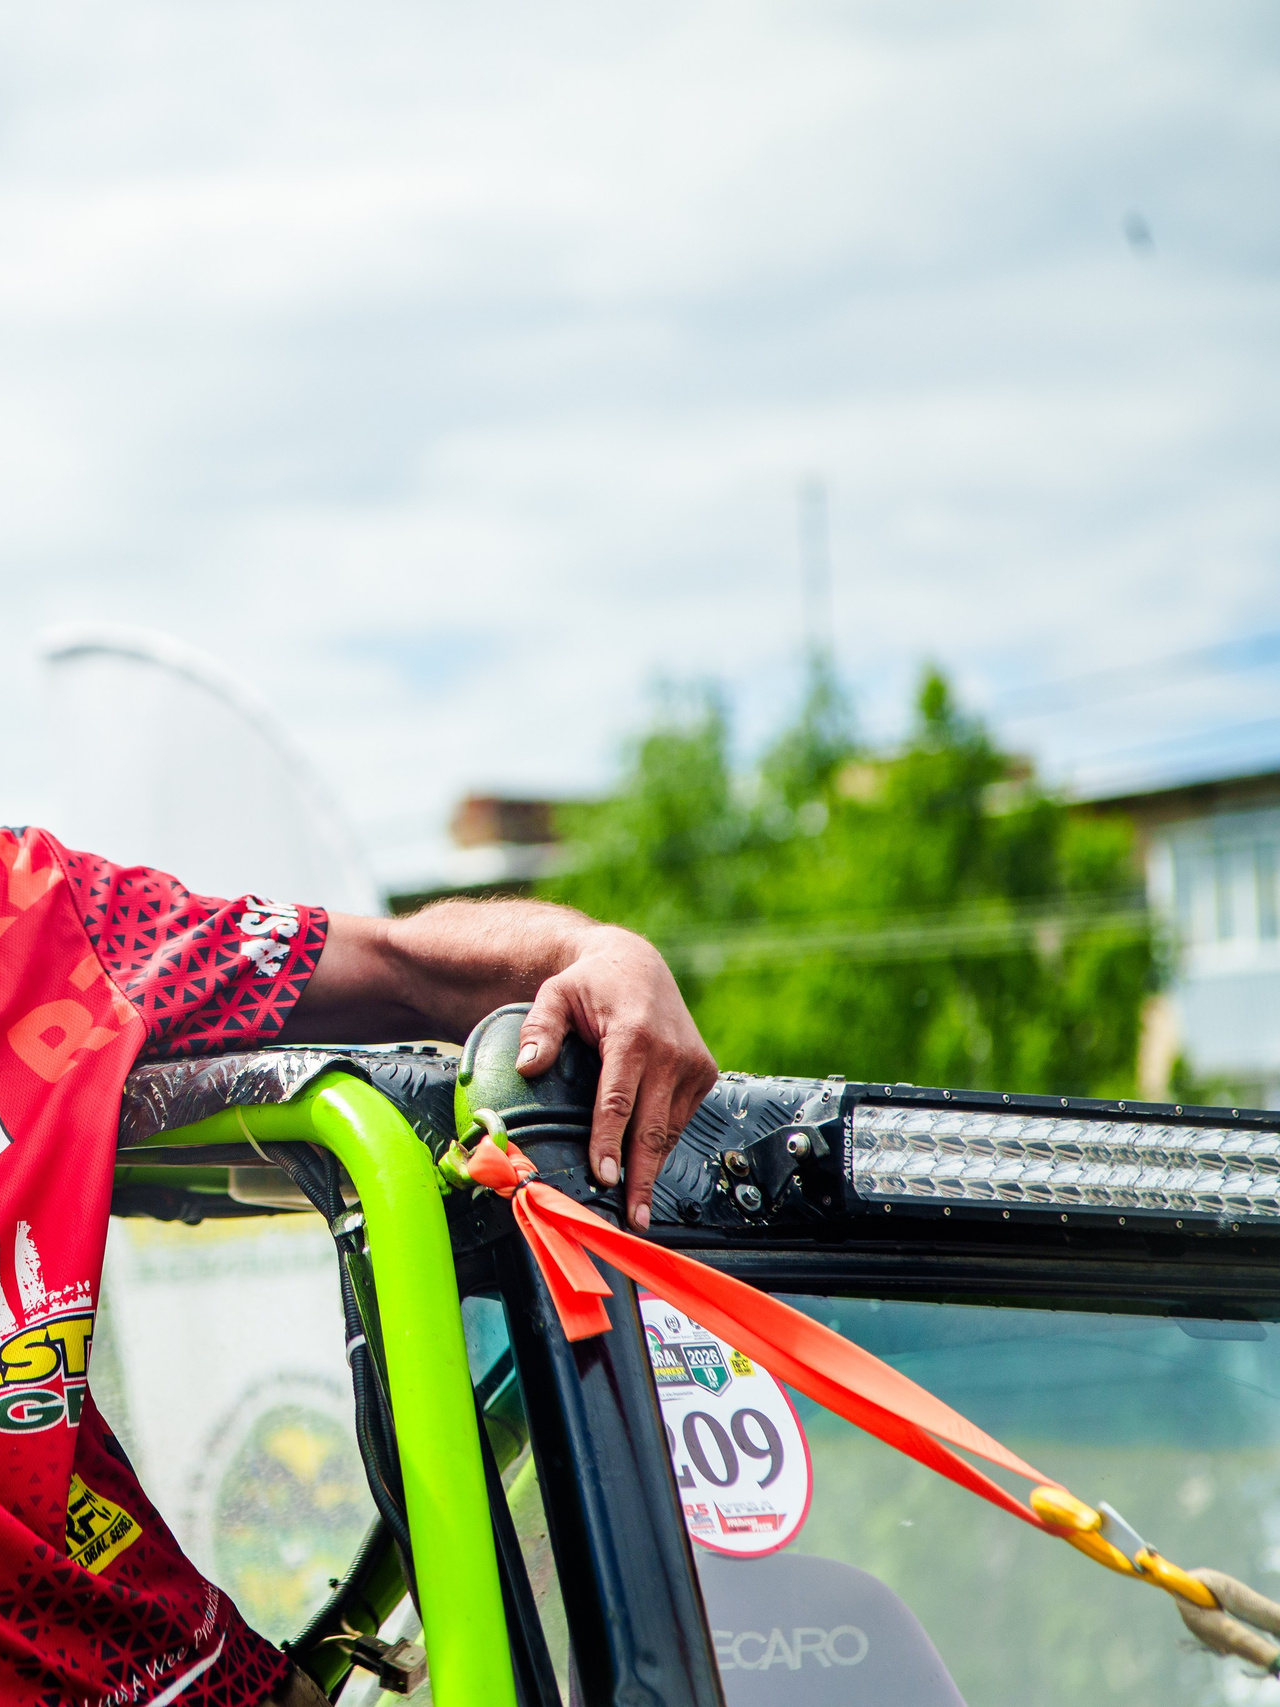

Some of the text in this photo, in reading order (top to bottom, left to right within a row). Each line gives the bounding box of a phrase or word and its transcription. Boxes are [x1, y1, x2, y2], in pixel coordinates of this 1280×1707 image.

[843, 1112, 852, 1182] AURORA
[687, 1349, 720, 1366] 2026
[703, 1367, 718, 1381] 10
[74, 1515, 134, 1569] LOBAL SERIES
[146, 1646, 189, 1680] Wee
[710, 1625, 869, 1671] ECARO
